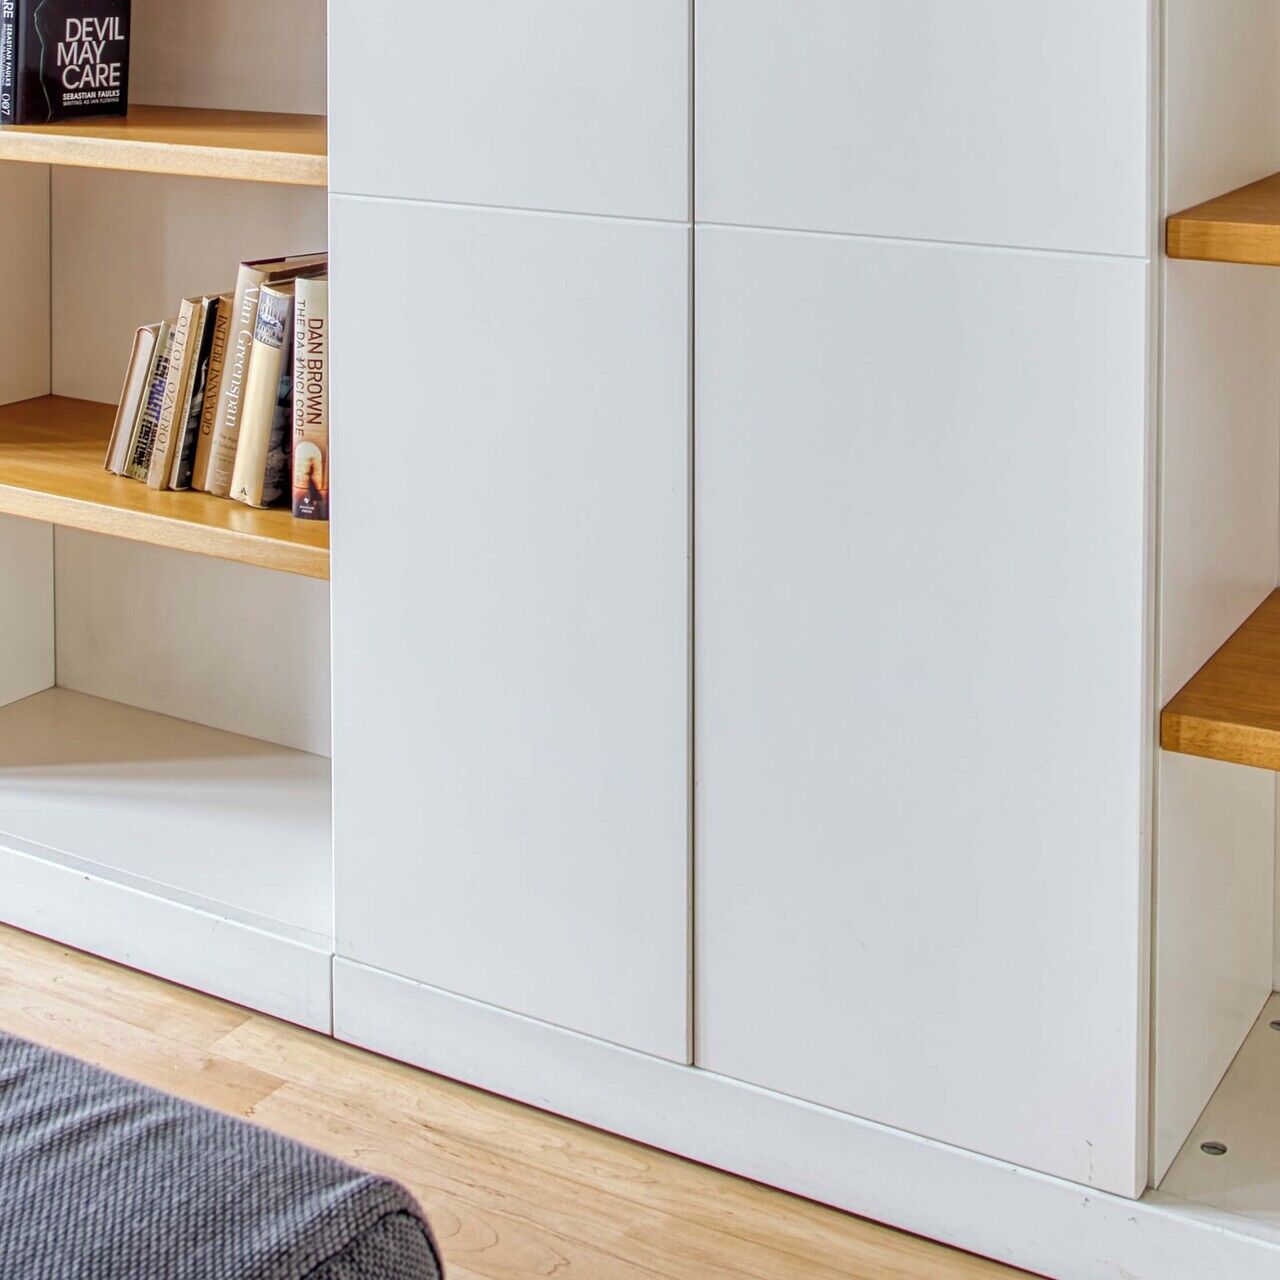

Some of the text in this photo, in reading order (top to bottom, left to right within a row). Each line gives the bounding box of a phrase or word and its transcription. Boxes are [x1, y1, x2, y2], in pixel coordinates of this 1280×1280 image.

[65, 17, 125, 42] DEVIL
[56, 41, 106, 67] MAY
[62, 62, 121, 89] CARE
[62, 89, 120, 101] SEBASTIAN FAULKS
[240, 279, 260, 324] Alan
[296, 299, 306, 325] THE
[296, 331, 305, 349] DA
[156, 315, 187, 453] LORENZO LOTTO
[202, 314, 229, 437] GIOVANNI BELLINI
[224, 329, 253, 428] Greenspan
[307, 318, 324, 426] DAN BROWN
[295, 398, 305, 437] CODE
